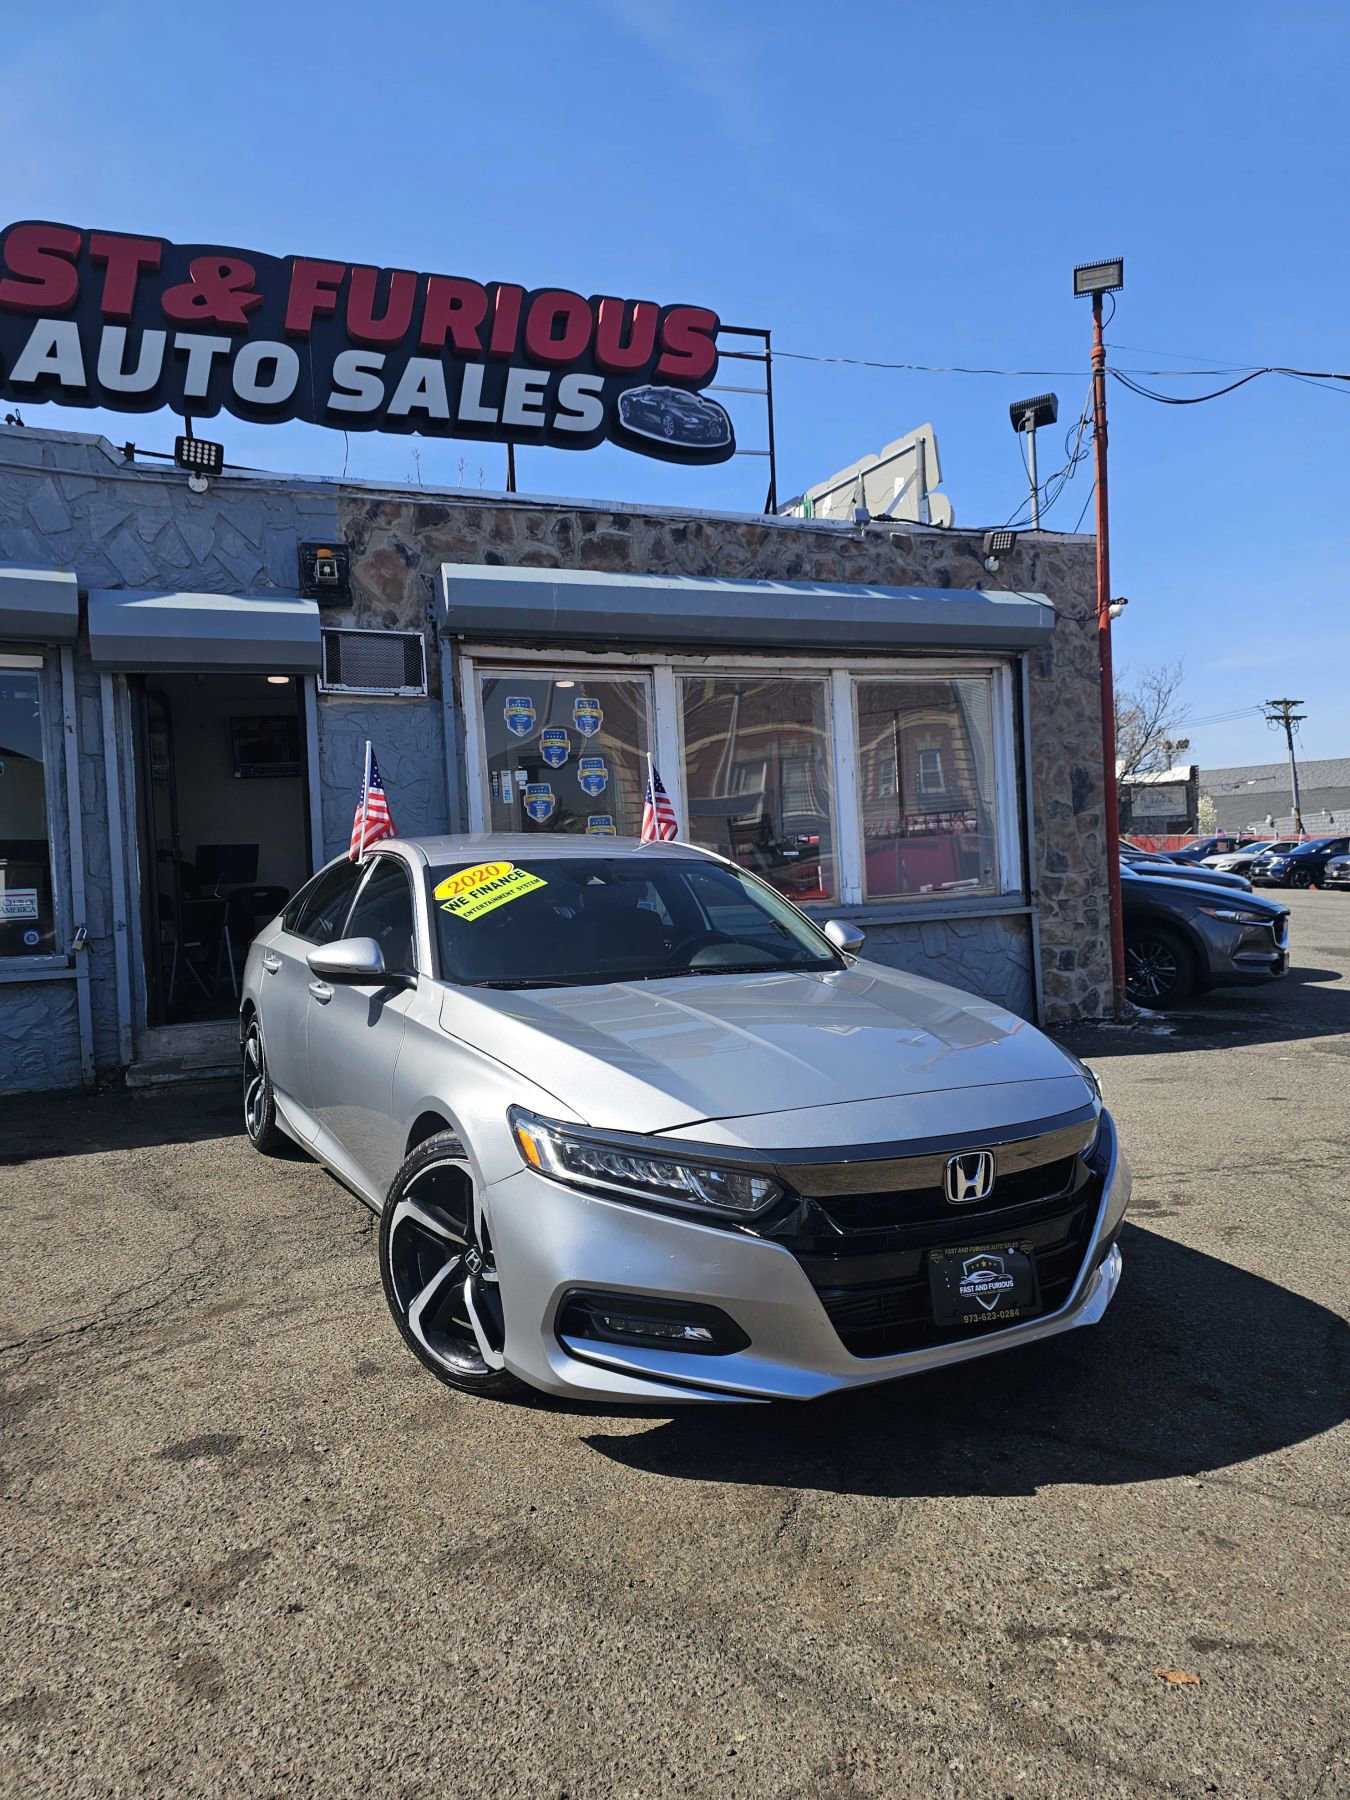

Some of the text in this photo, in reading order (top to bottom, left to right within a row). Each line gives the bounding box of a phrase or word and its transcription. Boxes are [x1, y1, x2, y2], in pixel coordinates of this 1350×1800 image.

[160, 255, 264, 327] &
[284, 258, 719, 382] FURIOUS
[8, 317, 605, 432] AUTO SALES
[444, 870, 526, 912] WE FINANCE
[447, 865, 500, 895] 2020
[463, 878, 542, 918] ENTERTAINMENT SYSTEM
[960, 1286, 975, 1294] FAST
[975, 1283, 988, 1291] AND
[988, 1280, 1014, 1290] FURIOUS
